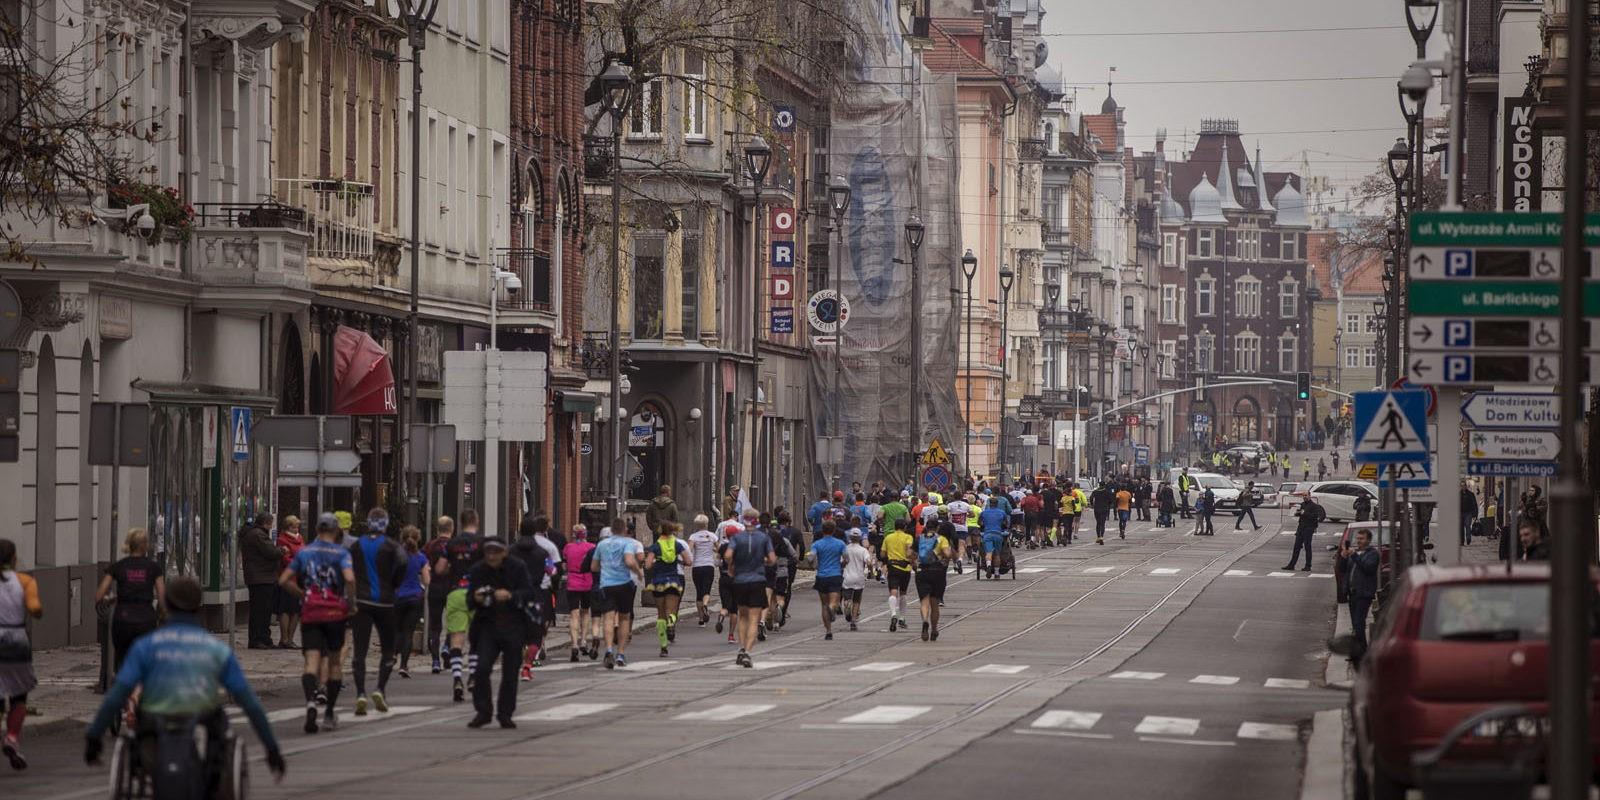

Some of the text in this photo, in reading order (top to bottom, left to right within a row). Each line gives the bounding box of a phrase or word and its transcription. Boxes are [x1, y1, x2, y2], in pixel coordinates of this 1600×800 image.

[1418, 223, 1435, 235] ul.
[1439, 223, 1503, 237] Wybrzeże
[1506, 223, 1543, 235] Armii
[1462, 292, 1560, 308] ul. Barlickiego
[1485, 396, 1552, 408] Młodzieżowy
[1485, 409, 1560, 421] Dom Kultu
[1494, 434, 1543, 444] Palmiarnia
[1501, 446, 1536, 458] Miejska
